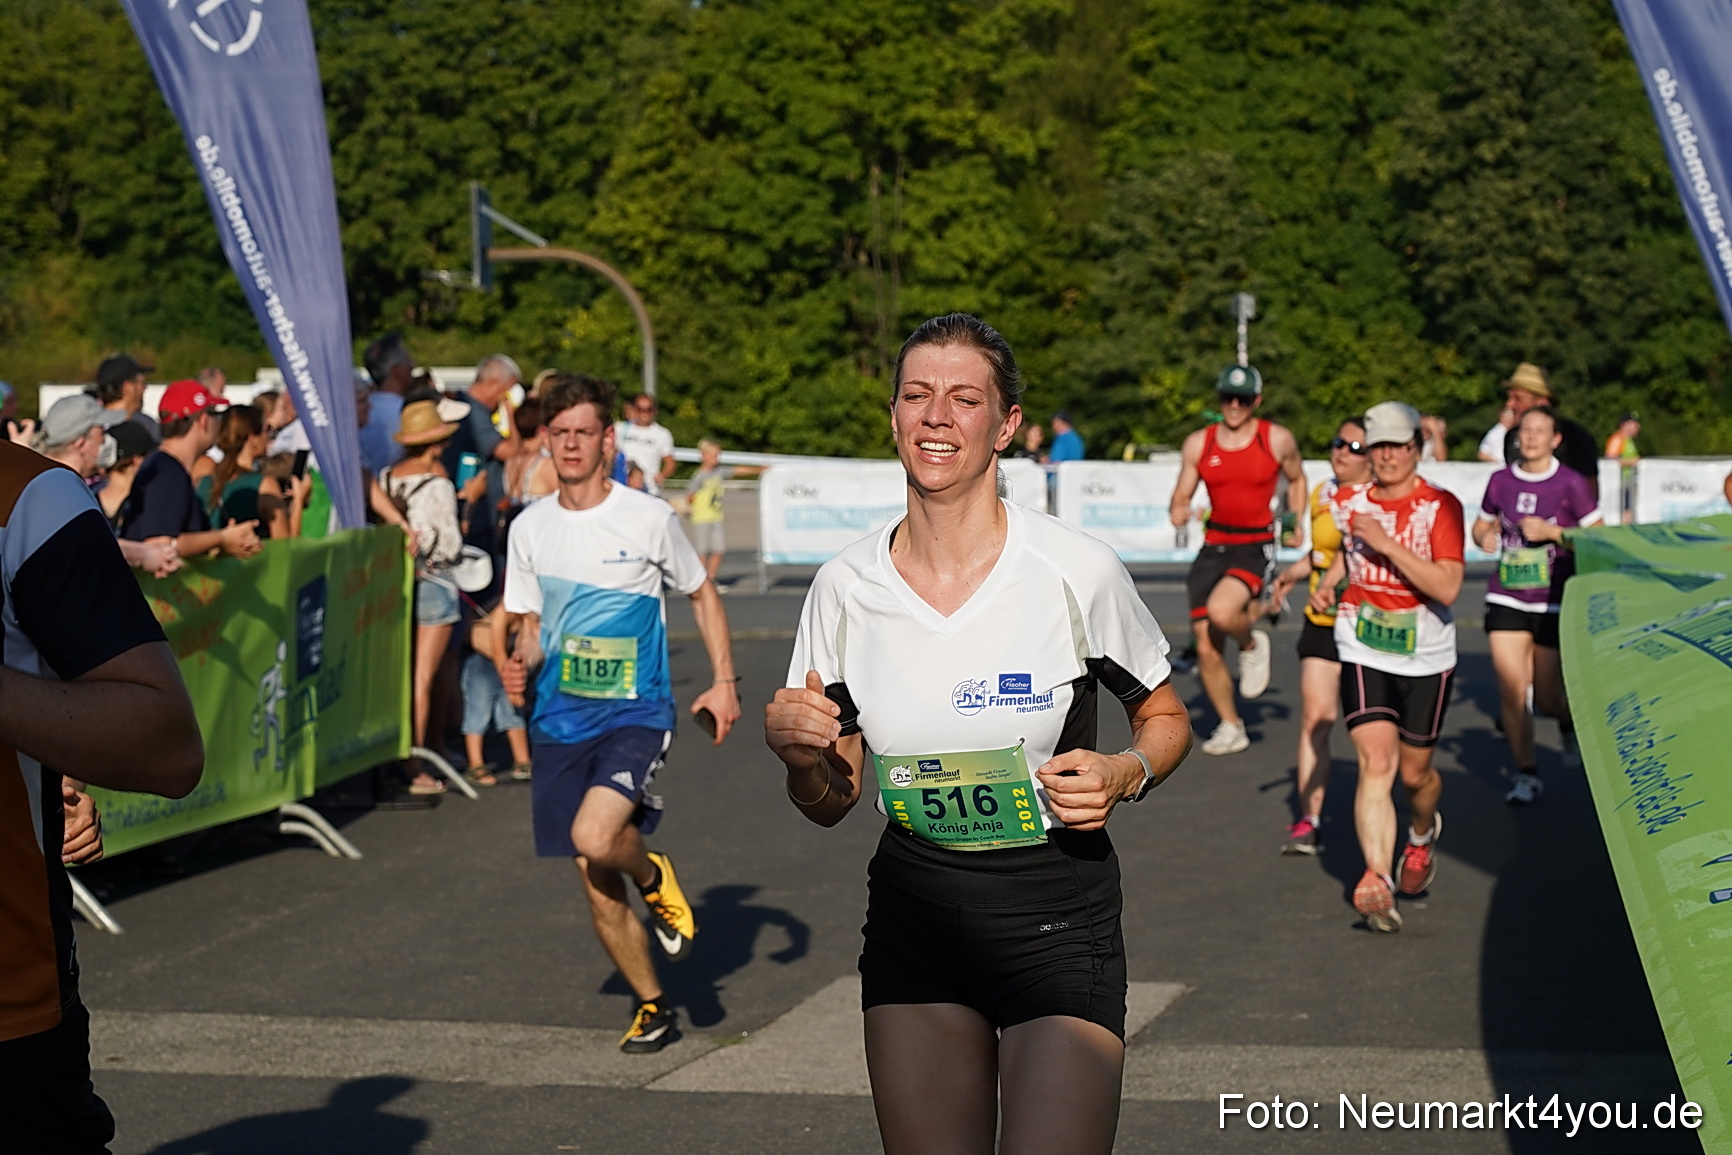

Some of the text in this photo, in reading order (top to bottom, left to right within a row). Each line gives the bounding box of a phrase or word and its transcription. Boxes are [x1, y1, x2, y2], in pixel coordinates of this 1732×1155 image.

[572, 656, 622, 678] 1187
[988, 690, 1054, 707] Firmenlauf
[1016, 701, 1055, 714] neumarkt
[914, 768, 961, 782] Firmenlauf
[934, 775, 962, 784] neumarkt
[921, 784, 999, 820] 516
[1012, 786, 1036, 832] 2022
[892, 800, 915, 831] RUN
[927, 819, 1004, 835] König Anja
